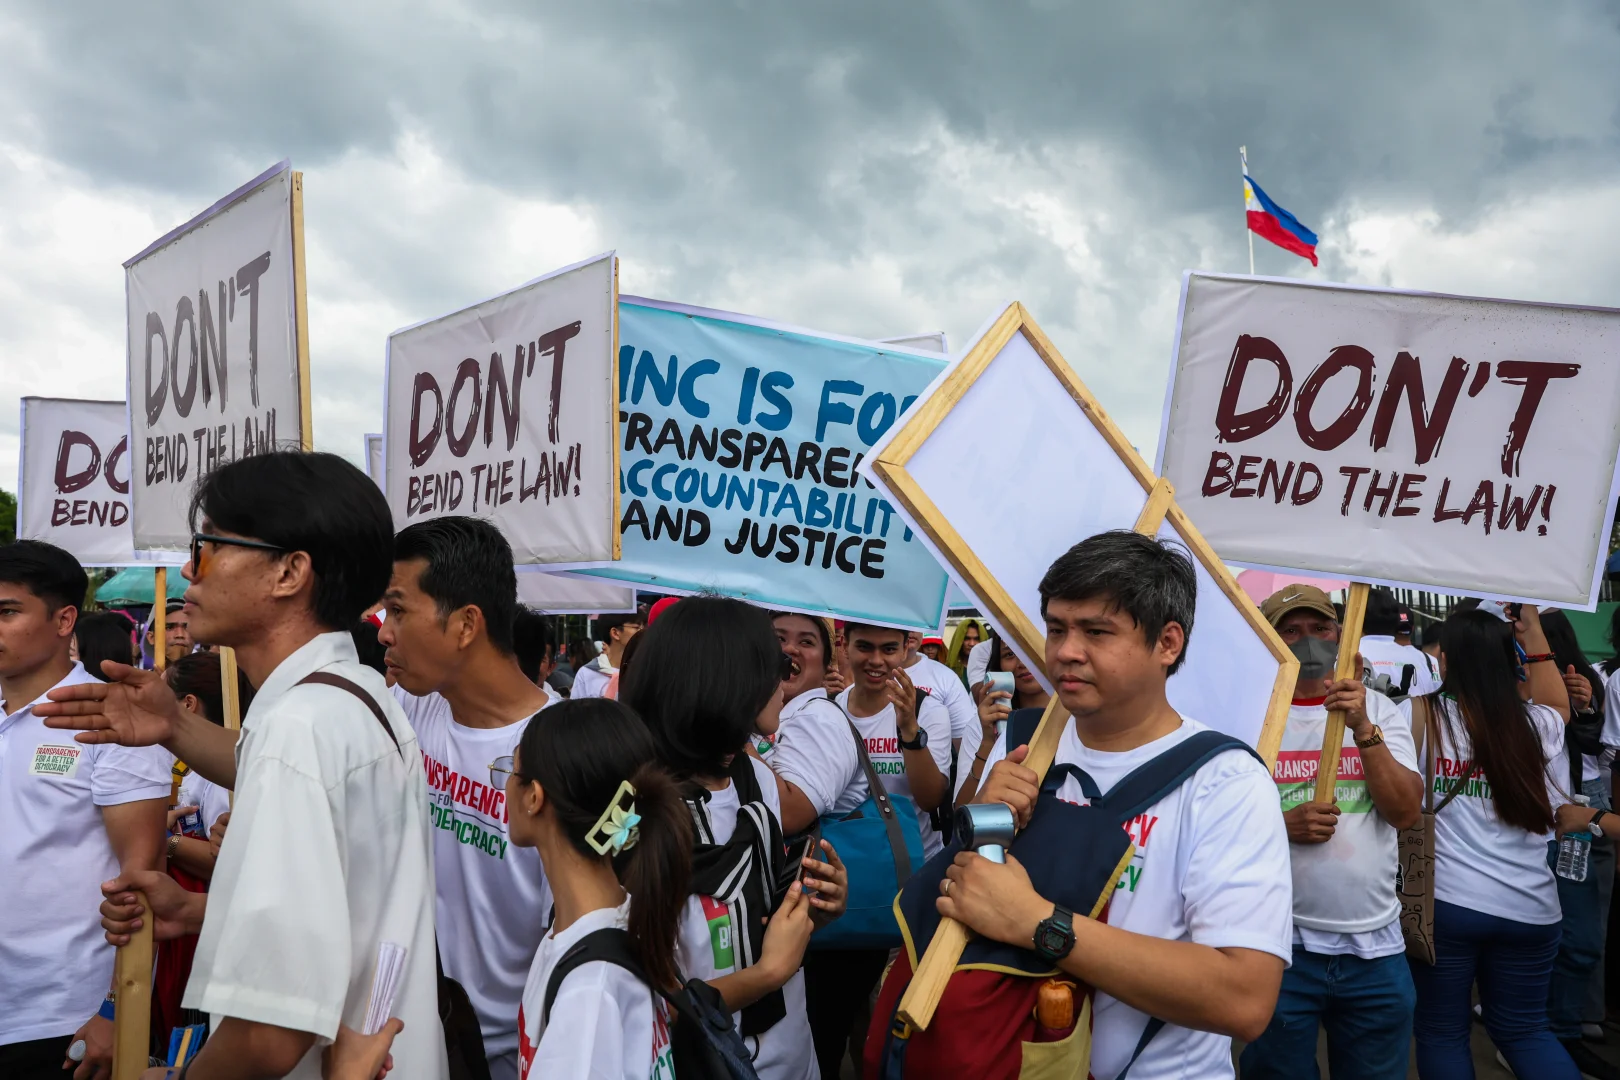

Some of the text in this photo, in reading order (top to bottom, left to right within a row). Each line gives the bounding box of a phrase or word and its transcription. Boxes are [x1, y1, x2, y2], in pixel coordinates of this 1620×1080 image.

[145, 251, 271, 428] DON'T
[408, 320, 582, 469] DON'T
[618, 344, 919, 448] INC IS FO
[1214, 333, 1582, 478] DON'T
[146, 432, 188, 487] BEND
[406, 442, 582, 518] BEND THE LAW!
[1201, 450, 1558, 537] BEND THE LAW!
[51, 499, 129, 527] BEND
[619, 458, 914, 542] CCOUNTABILIT
[620, 499, 887, 579] AND JUSTICE
[34, 763, 70, 772] DEMOCRACY
[35, 755, 46, 763] FOR
[51, 756, 75, 765] BETTER
[36, 747, 80, 757] TRANSPARENCY
